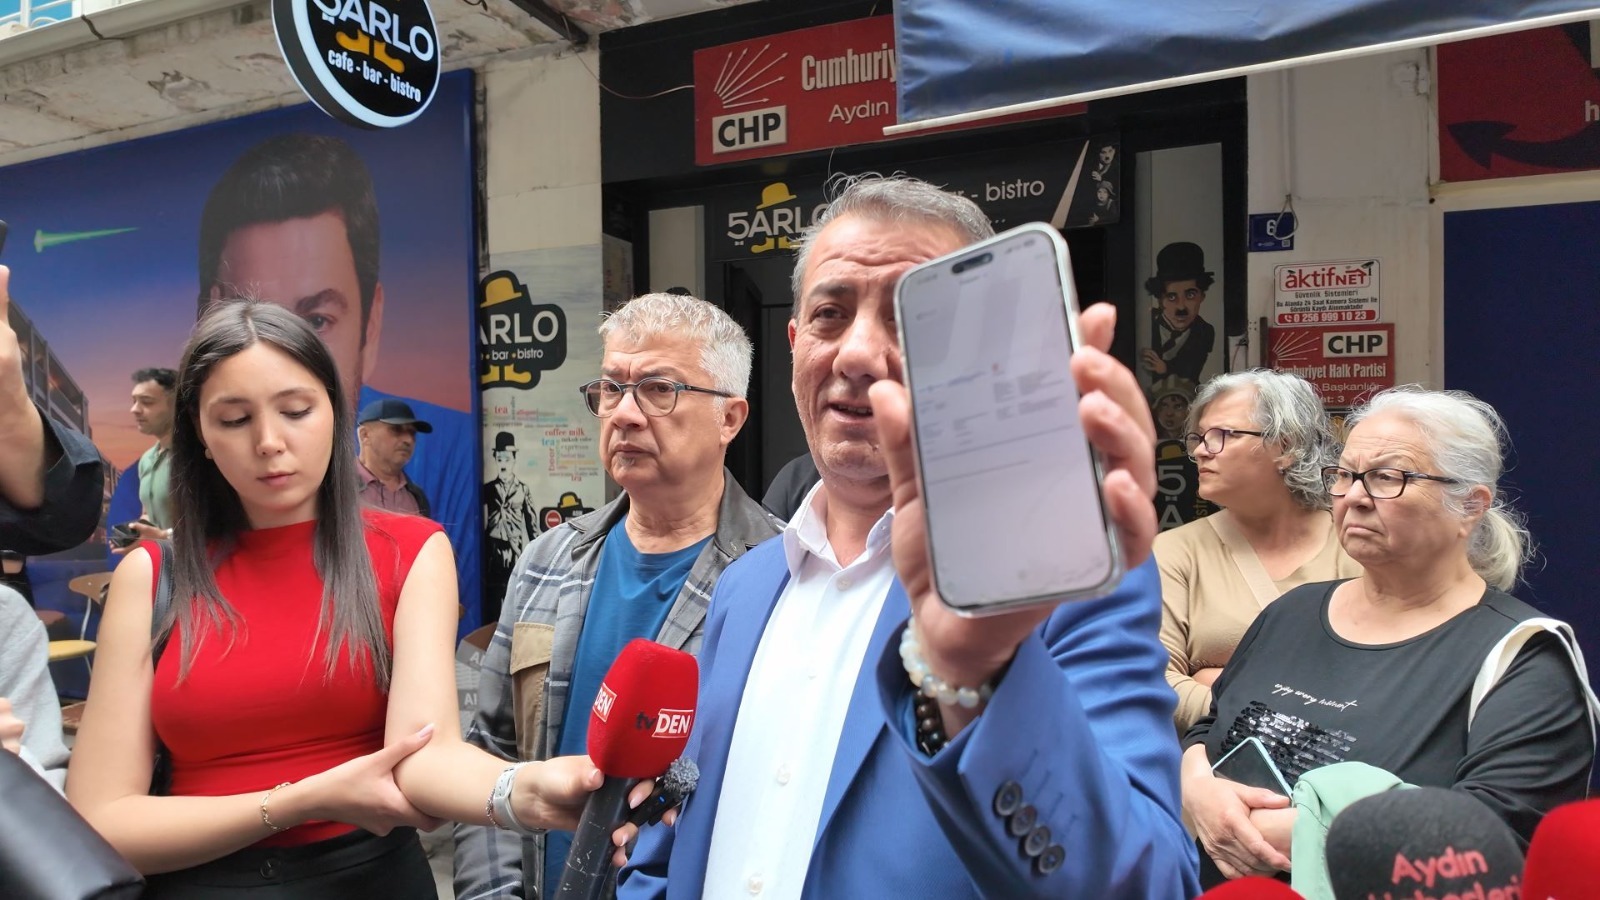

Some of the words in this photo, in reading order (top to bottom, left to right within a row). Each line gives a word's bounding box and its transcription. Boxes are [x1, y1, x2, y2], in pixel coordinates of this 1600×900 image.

[328, 49, 354, 73] cafe
[362, 61, 382, 85] bar
[390, 73, 422, 103] bistro
[828, 101, 889, 125] Aydın
[717, 114, 781, 147] CHP
[986, 179, 1045, 202] bistro
[1266, 219, 1276, 236] 6
[1295, 291, 1321, 300] Güvenlik
[1325, 289, 1359, 297] Sistemleri
[1341, 311, 1353, 319] 10
[1355, 310, 1367, 318] 23
[1328, 334, 1383, 354] CHP
[492, 350, 509, 360] bar
[517, 348, 544, 359] bistro
[1330, 363, 1351, 379] Halk
[1353, 362, 1387, 378] Partisi
[1337, 395, 1345, 403] 3
[494, 405, 508, 415] tea
[545, 428, 567, 437] coffee
[569, 427, 585, 437] milk
[1392, 846, 1488, 888] Aydın
